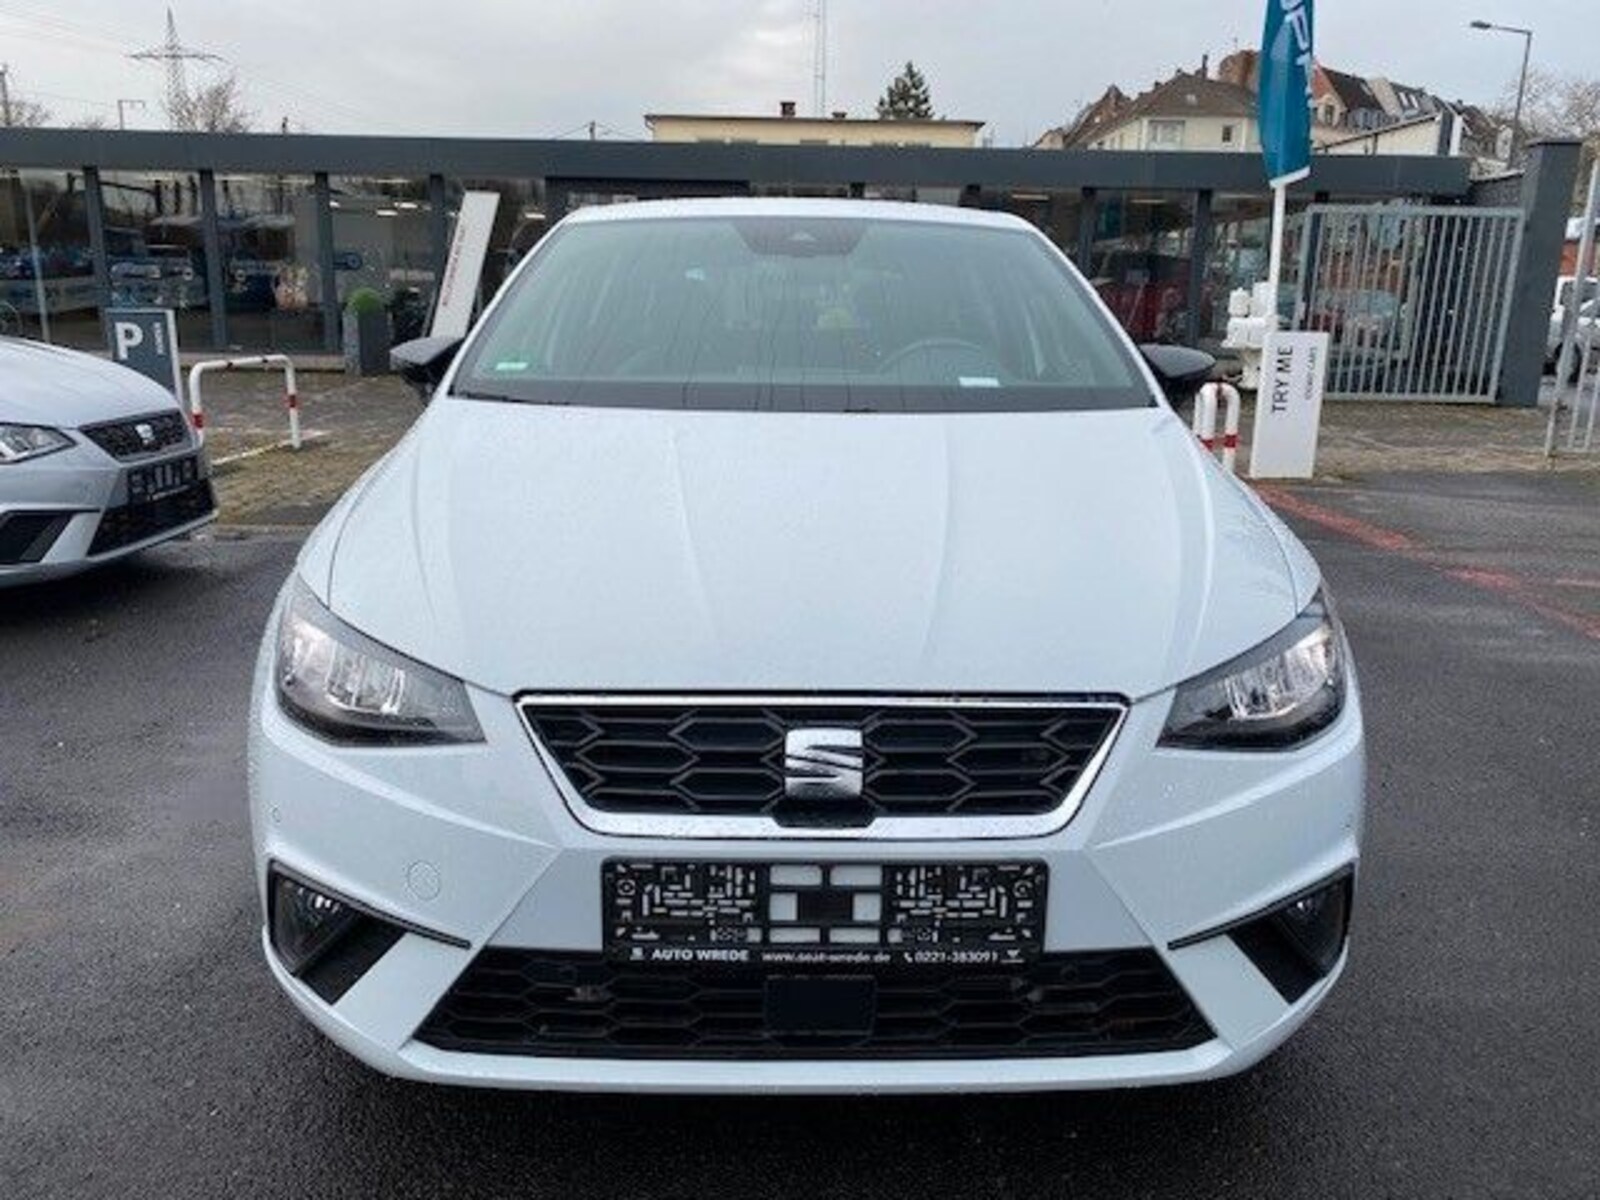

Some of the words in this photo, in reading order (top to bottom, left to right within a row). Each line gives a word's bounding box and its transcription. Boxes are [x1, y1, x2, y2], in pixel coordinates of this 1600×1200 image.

[115, 322, 143, 359] P
[1276, 345, 1293, 373] ME
[1271, 379, 1289, 413] TRY
[651, 949, 693, 960] AUTO
[696, 949, 749, 961] WREDE
